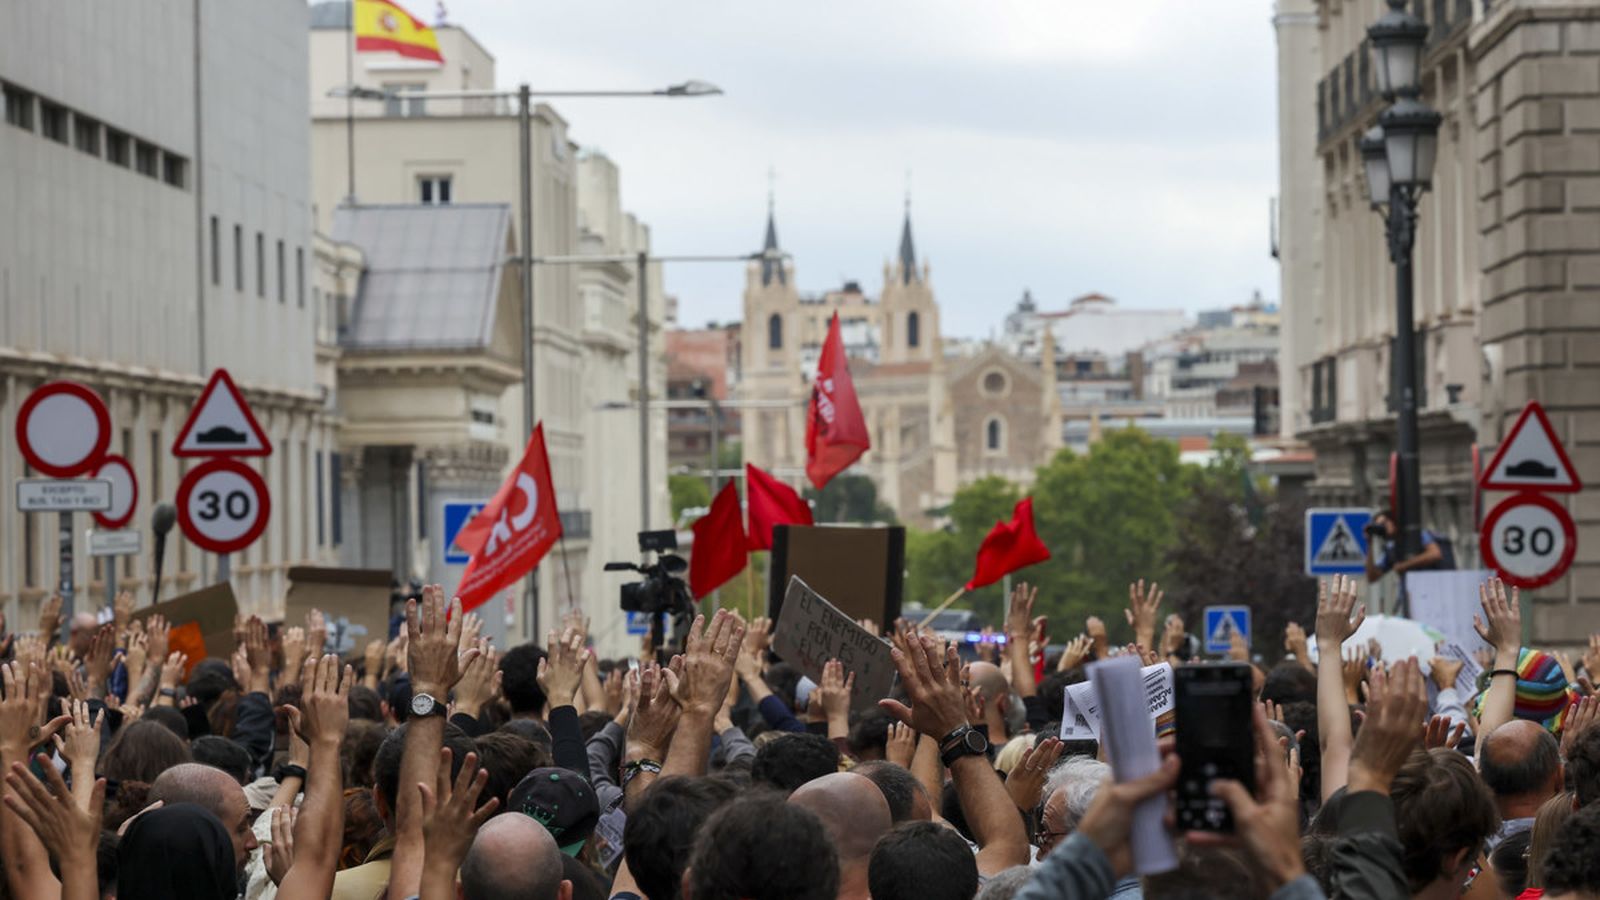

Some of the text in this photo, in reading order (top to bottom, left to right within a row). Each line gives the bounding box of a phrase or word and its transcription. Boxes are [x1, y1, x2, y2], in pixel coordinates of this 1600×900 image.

[198, 490, 251, 520] 30
[1503, 525, 1555, 556] 30
[800, 591, 878, 656] EL ENEMIGO
